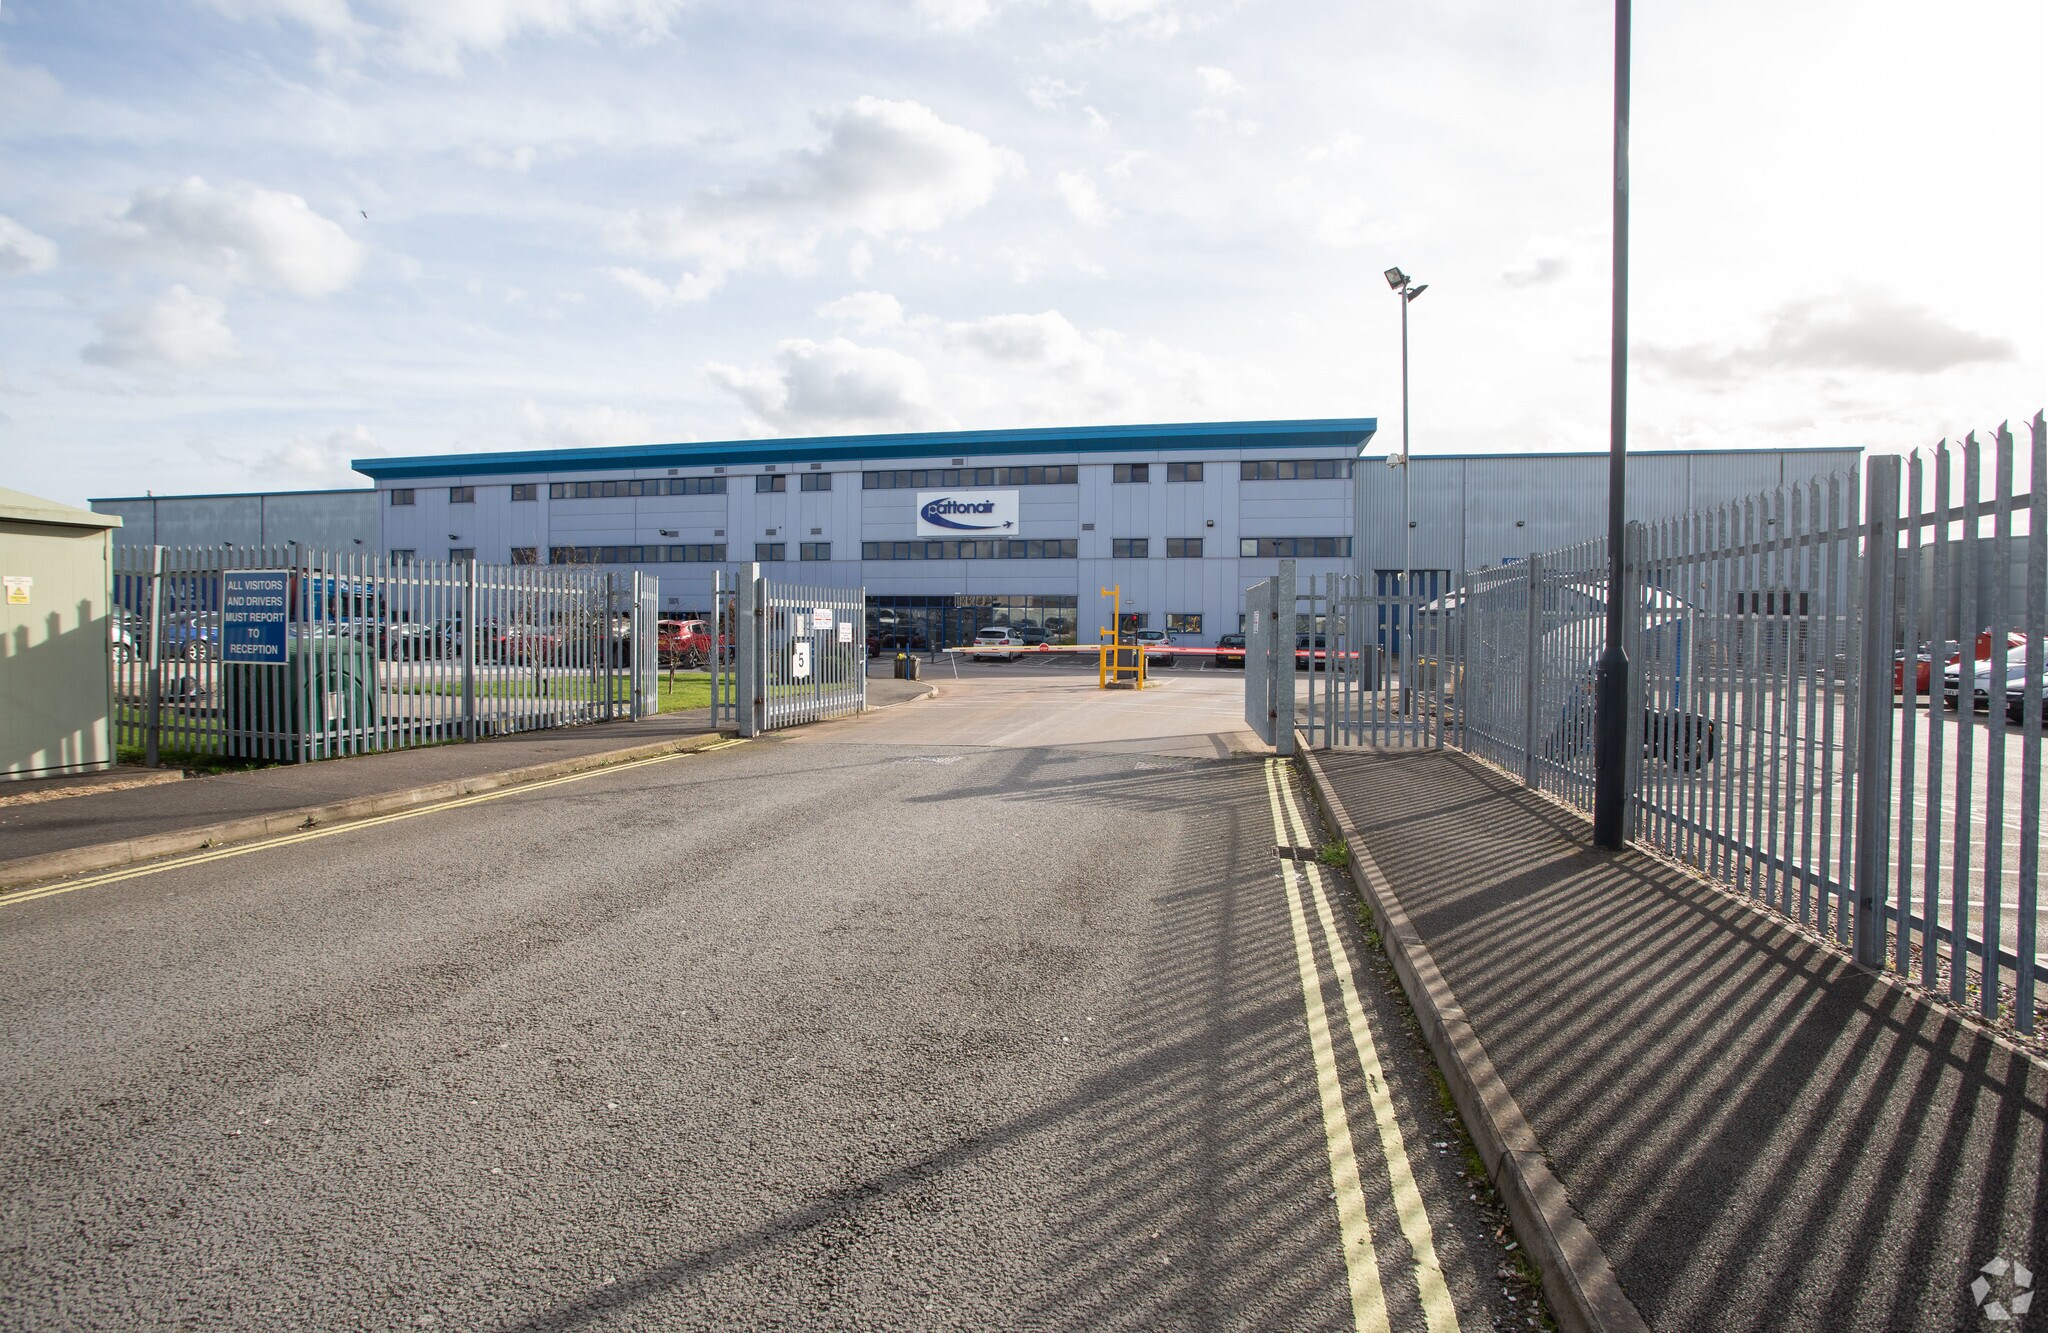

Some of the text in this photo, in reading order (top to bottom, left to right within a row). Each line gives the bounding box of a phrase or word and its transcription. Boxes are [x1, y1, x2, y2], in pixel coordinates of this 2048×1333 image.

[928, 500, 995, 518] pattonair
[227, 580, 283, 591] ALL VISITORS
[227, 596, 283, 607] AND DRIVERS
[225, 612, 284, 623] MUST REPORT
[247, 628, 260, 638] TO
[230, 644, 278, 654] RECEPTION
[798, 652, 804, 668] 5
